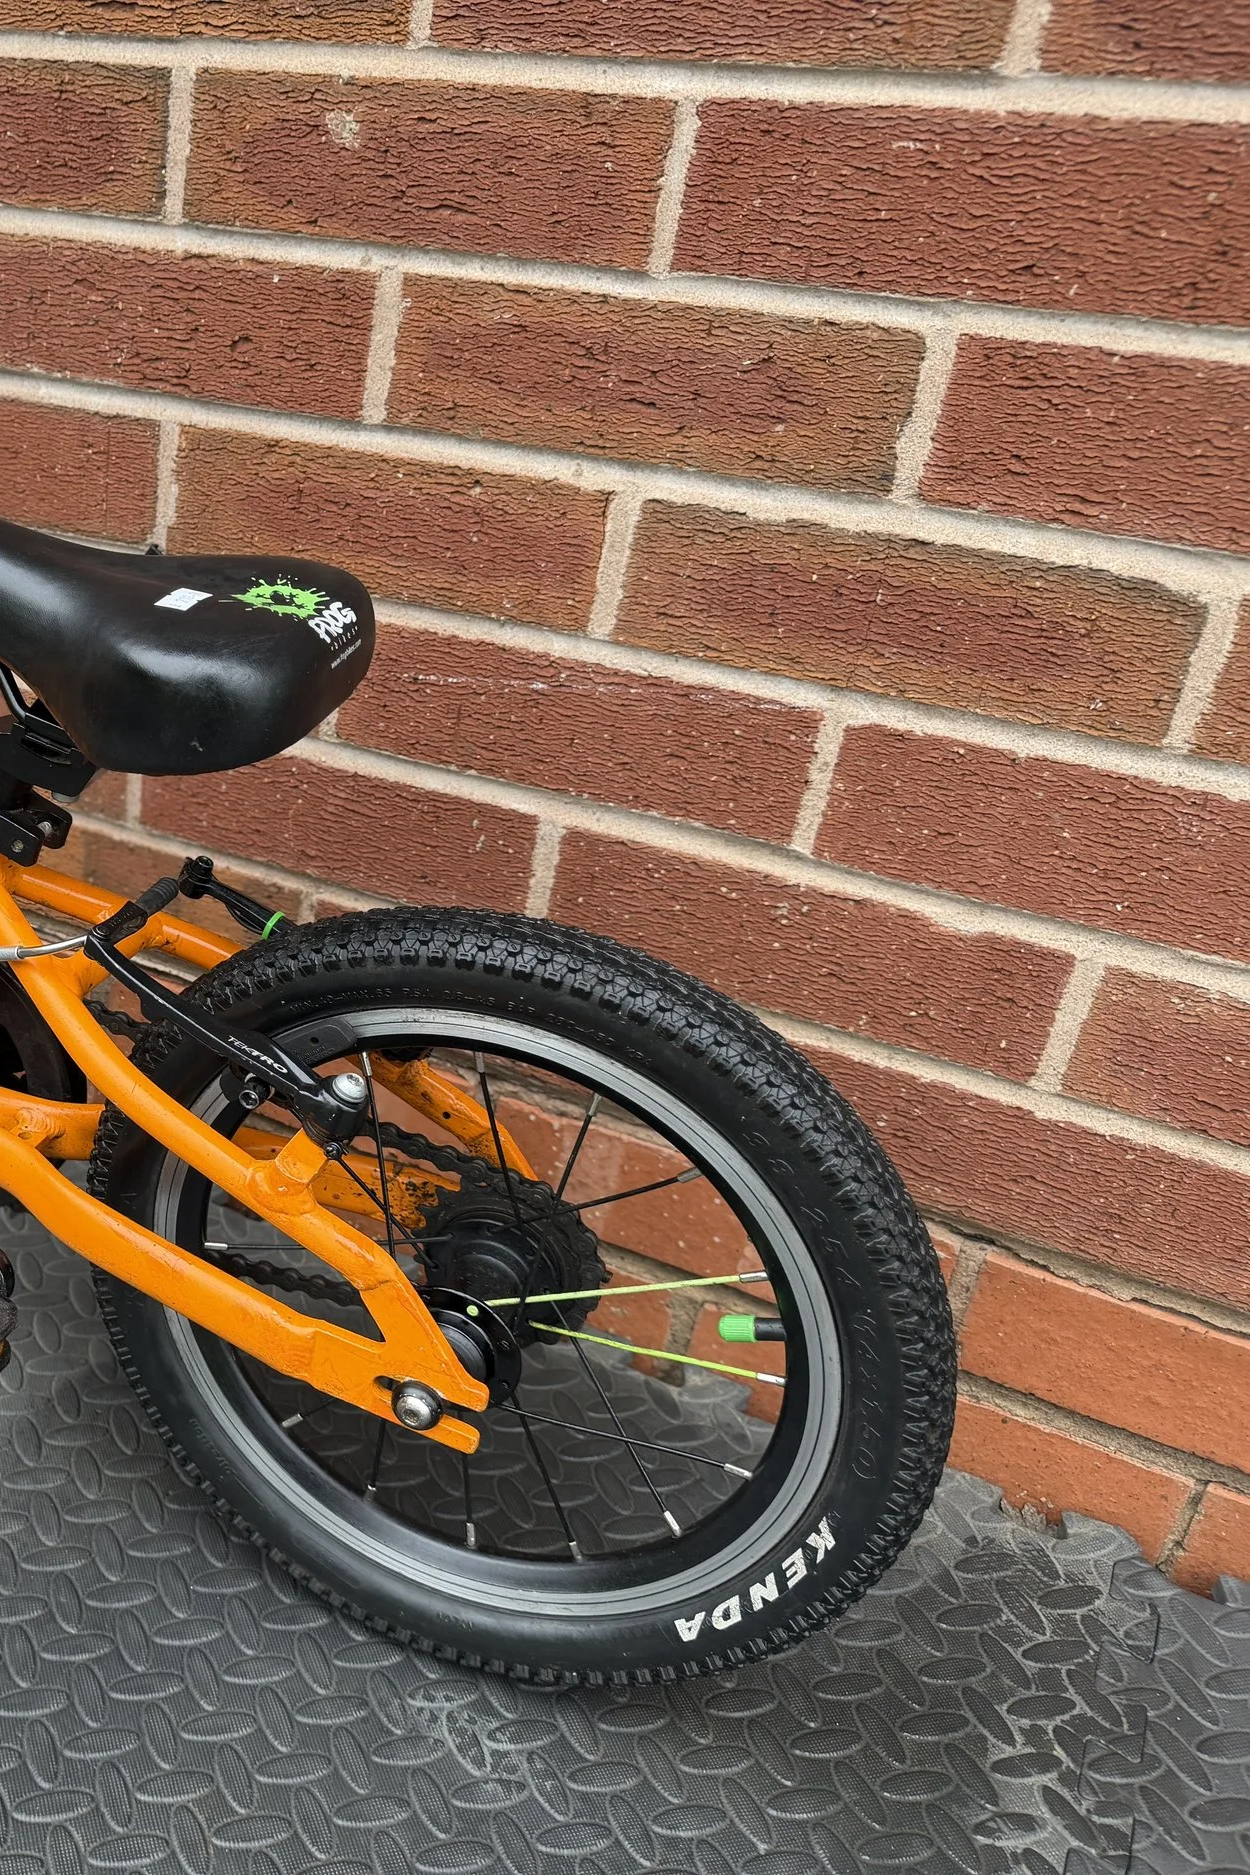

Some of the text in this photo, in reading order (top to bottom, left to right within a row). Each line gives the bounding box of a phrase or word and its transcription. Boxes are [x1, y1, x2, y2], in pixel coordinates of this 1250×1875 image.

[307, 601, 358, 644] FROG
[227, 1034, 289, 1074] TEKTRO
[673, 1516, 837, 1643] KENDA
